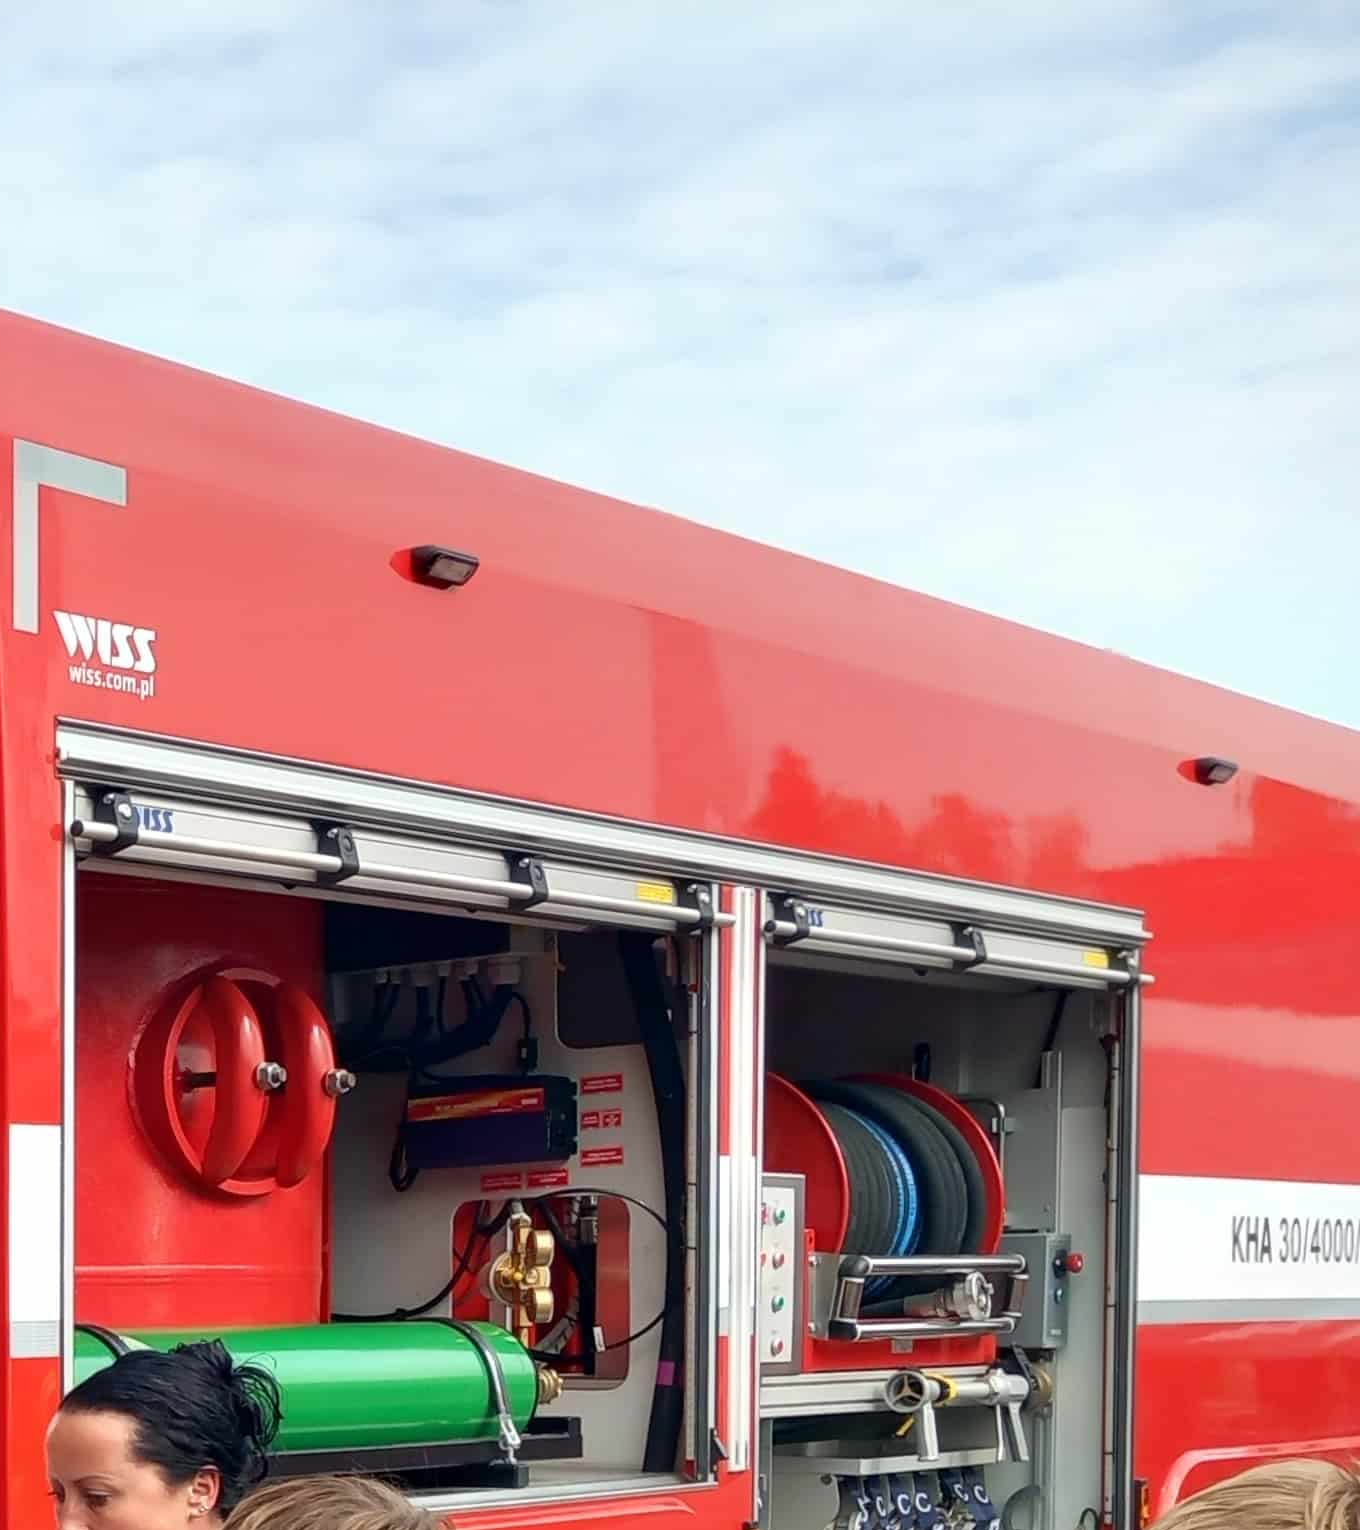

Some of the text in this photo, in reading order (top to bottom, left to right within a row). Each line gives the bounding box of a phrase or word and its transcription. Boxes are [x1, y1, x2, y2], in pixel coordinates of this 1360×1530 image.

[53, 610, 156, 674] WISS
[68, 661, 155, 700] wiss.com.pl
[134, 806, 174, 834] ISS
[1231, 1215, 1273, 1264] KHA
[897, 1494, 912, 1515] C
[914, 1492, 932, 1513] C
